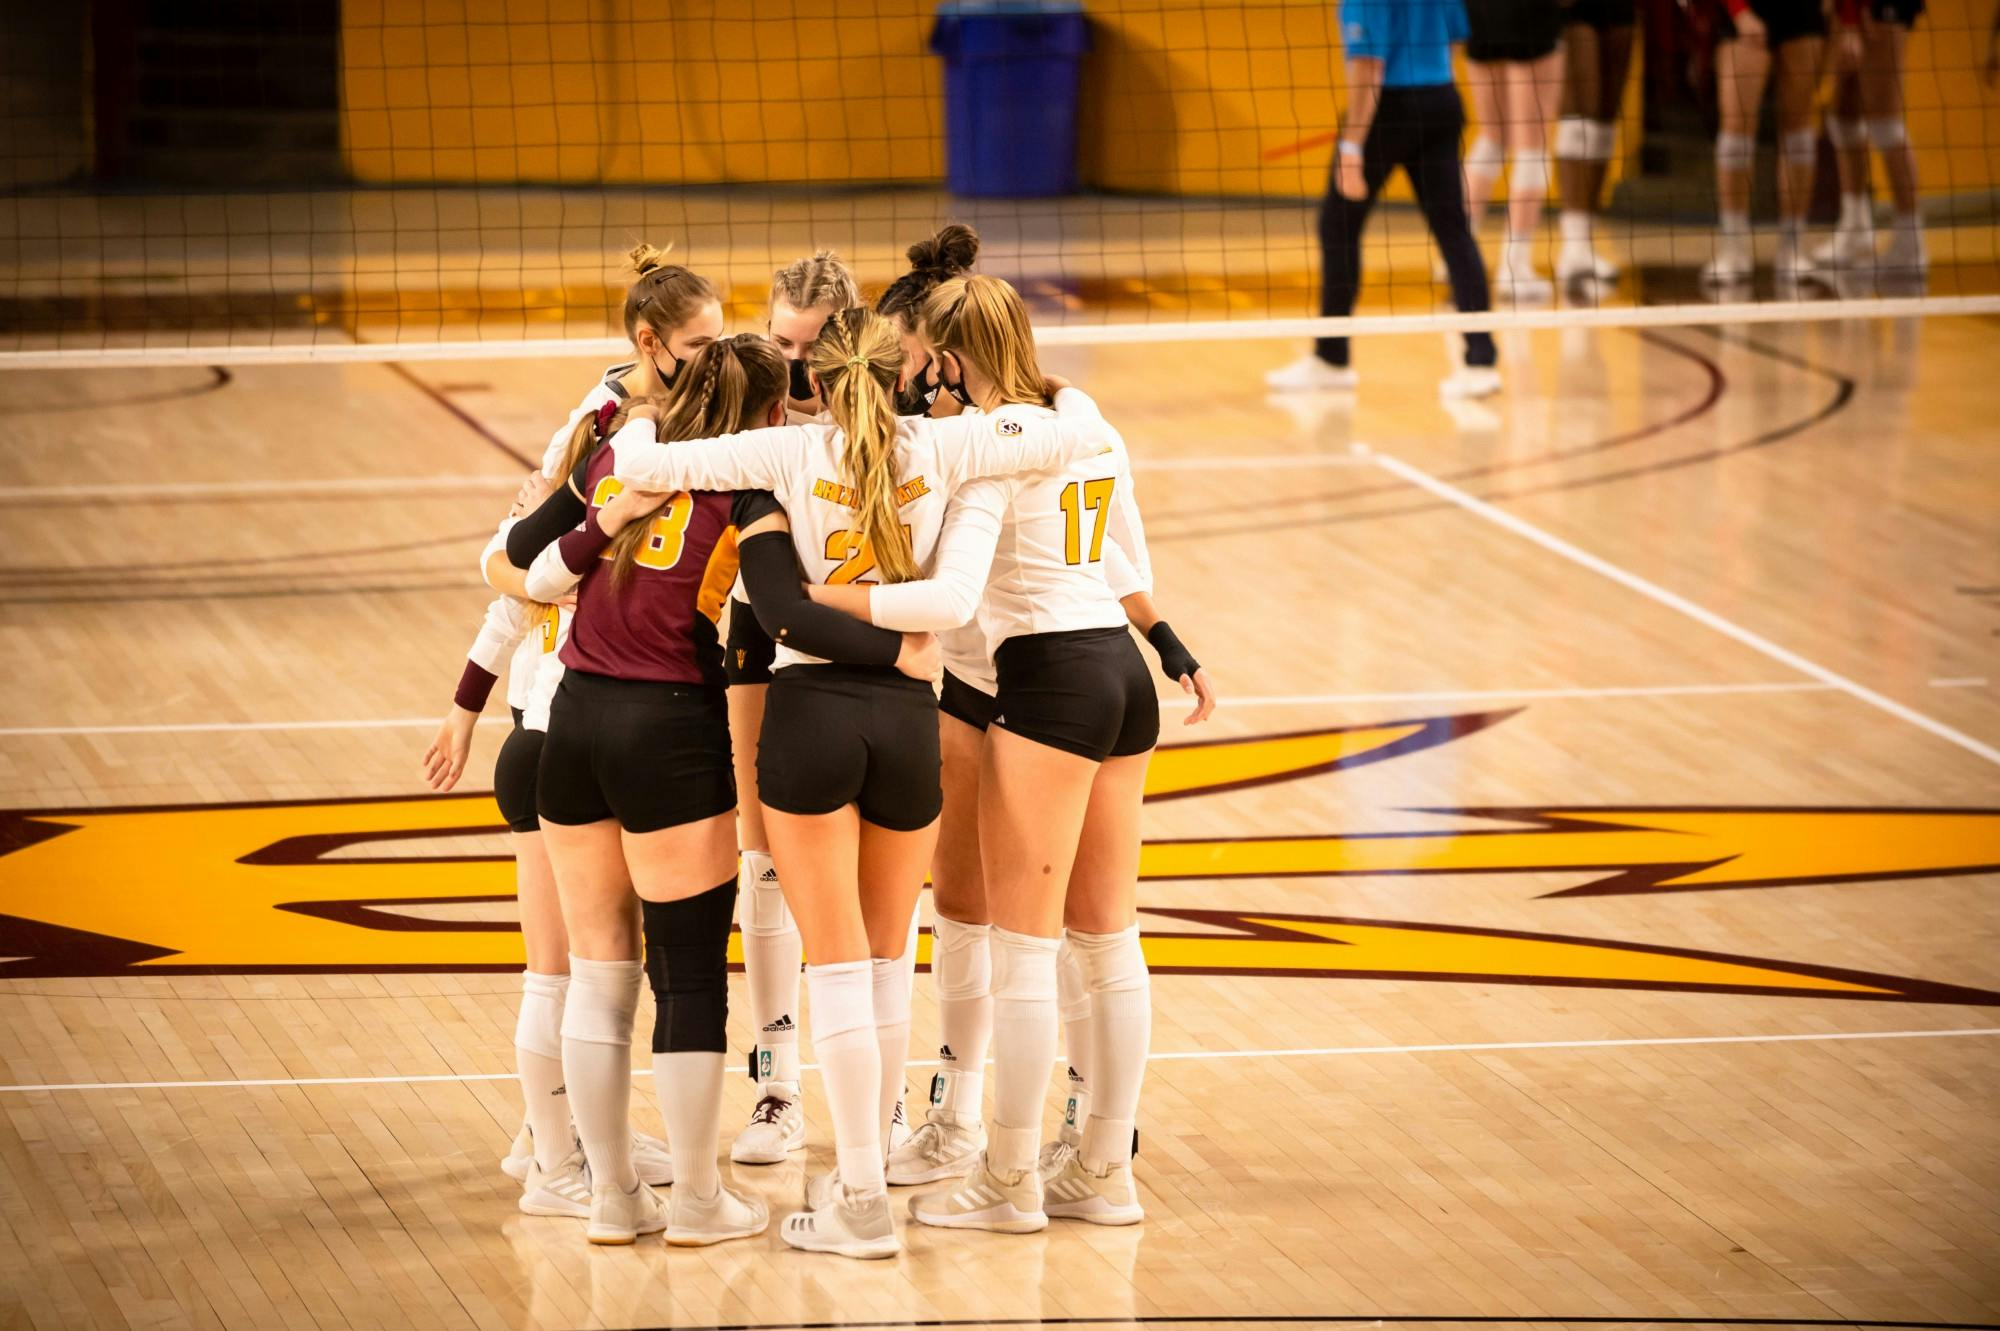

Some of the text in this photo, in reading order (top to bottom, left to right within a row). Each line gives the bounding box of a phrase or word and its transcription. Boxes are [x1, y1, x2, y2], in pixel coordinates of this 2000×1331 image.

[812, 478, 861, 511] ARIZ
[896, 474, 932, 509] ATE
[1059, 476, 1116, 566] 17
[824, 523, 914, 586] 2
